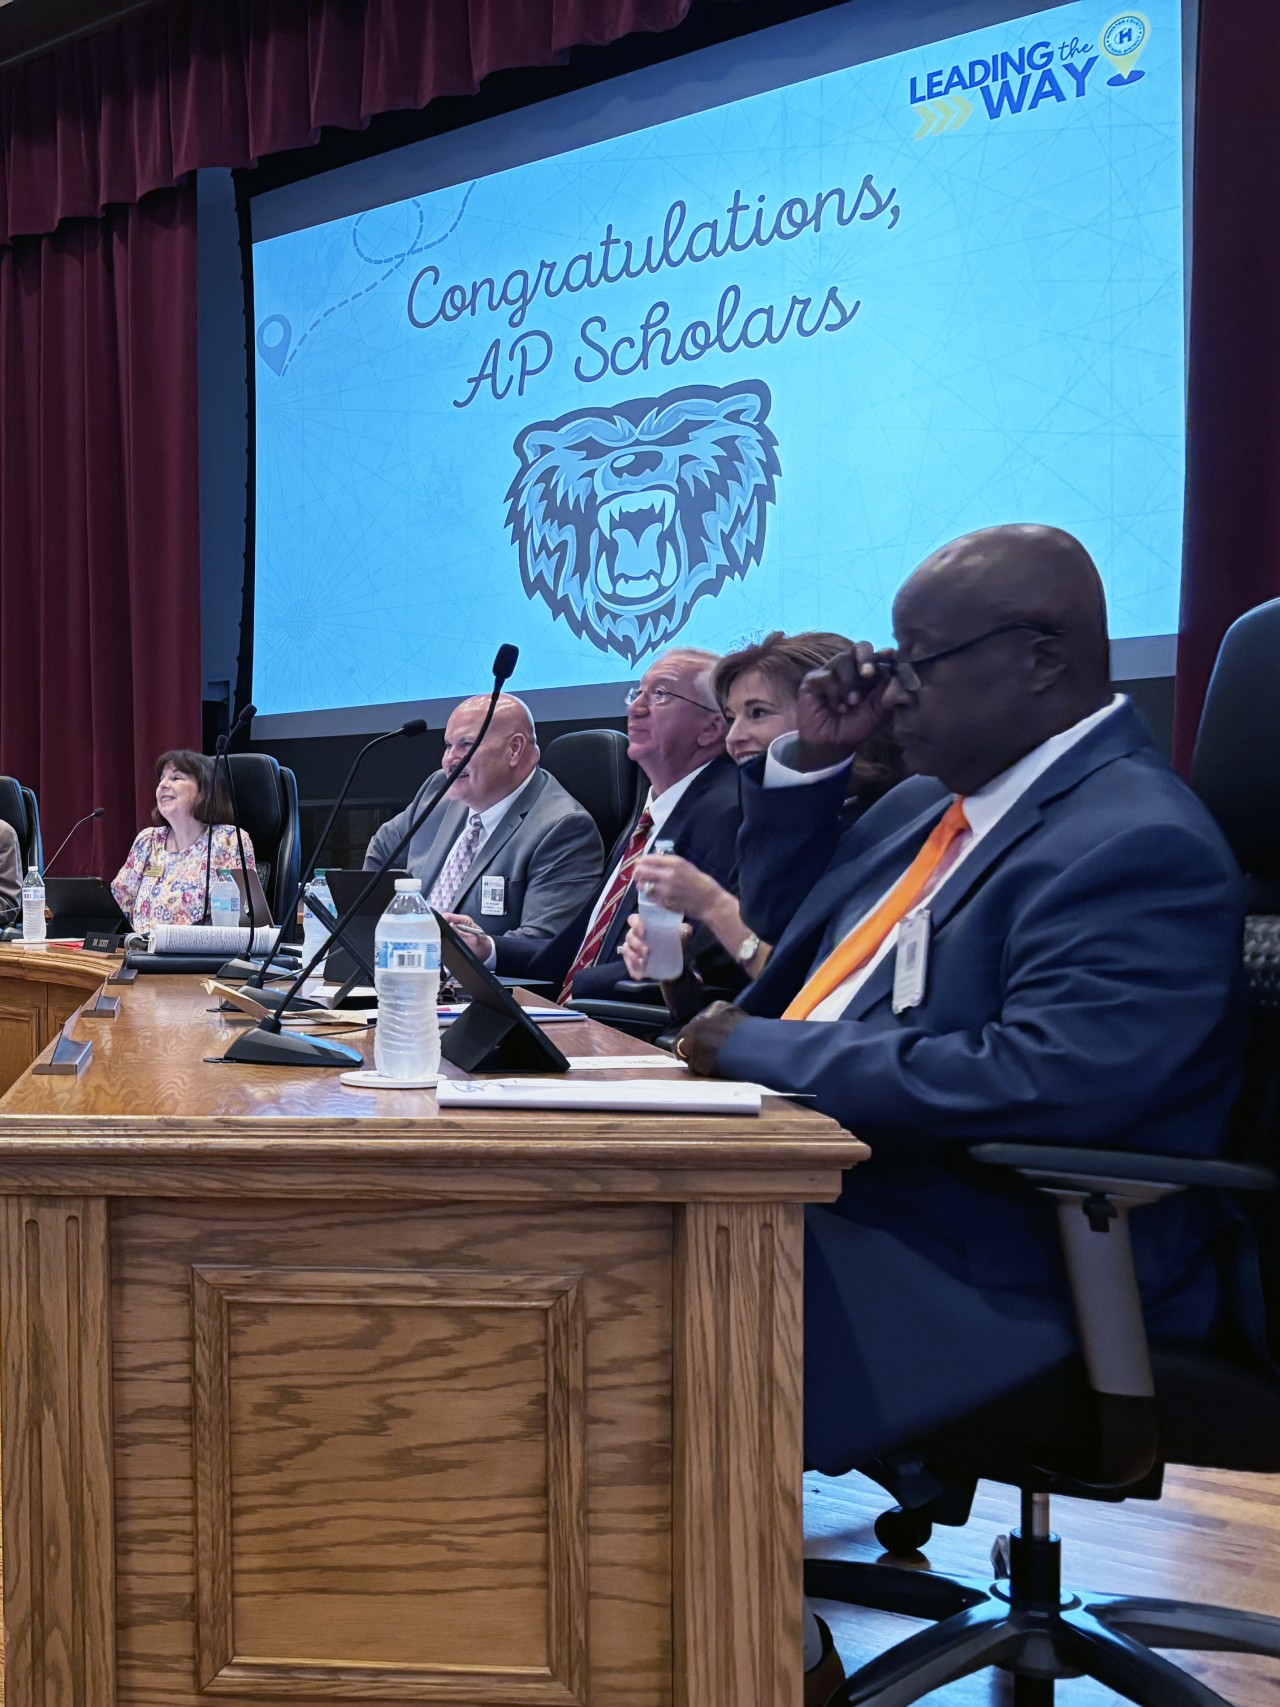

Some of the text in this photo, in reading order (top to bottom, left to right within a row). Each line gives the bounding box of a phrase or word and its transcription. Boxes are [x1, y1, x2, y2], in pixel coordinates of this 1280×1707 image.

[910, 37, 1094, 105] LEADING the
[980, 55, 1100, 120] WAY
[407, 174, 902, 329] Congratulations,
[453, 285, 861, 408] AP Scholars
